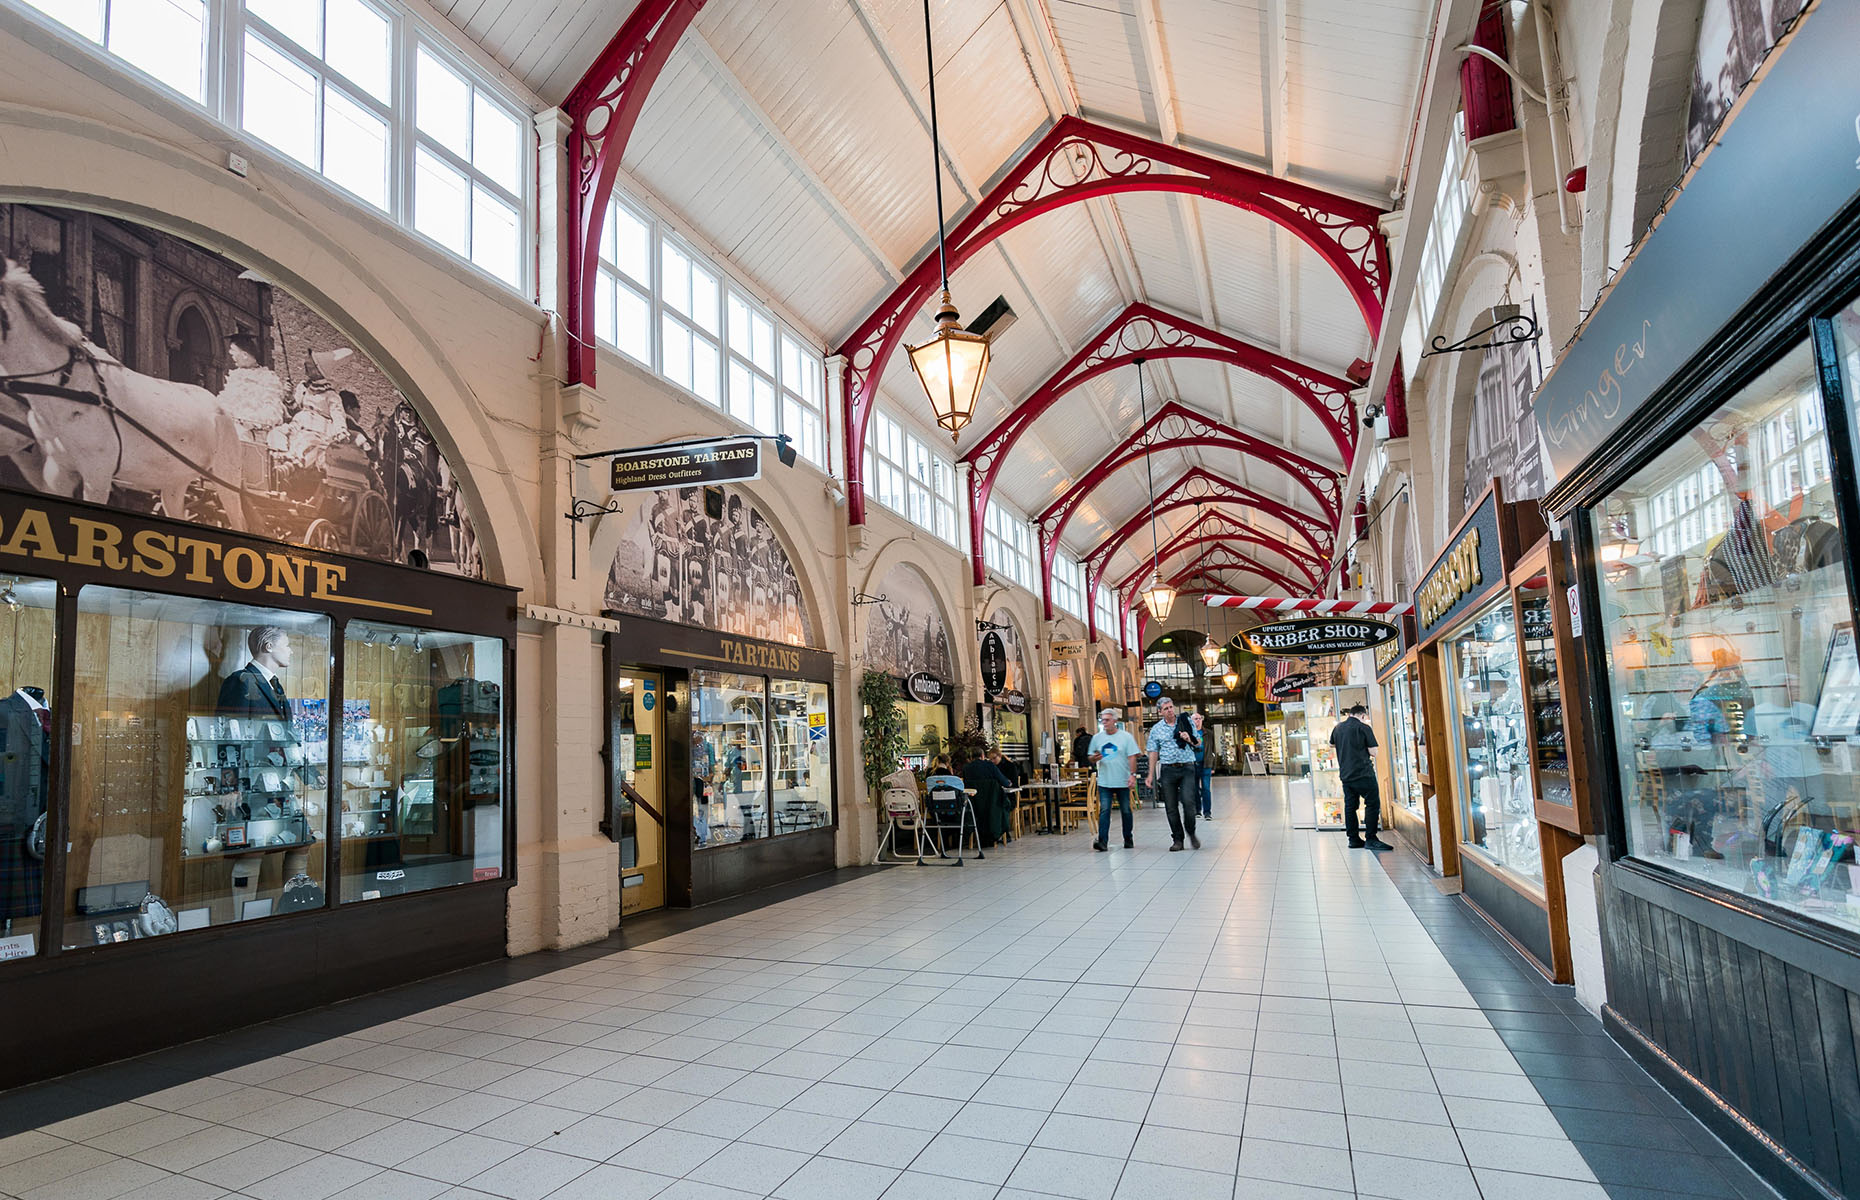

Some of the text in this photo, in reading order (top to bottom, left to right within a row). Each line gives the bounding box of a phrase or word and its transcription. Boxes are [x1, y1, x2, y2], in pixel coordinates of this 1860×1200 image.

[1546, 319, 1652, 450] Ginger
[615, 447, 755, 473] BOARSTONE TARTANS
[615, 468, 702, 486] Highland Dress Outfitters
[0, 507, 347, 600] ARSTONE
[1249, 624, 1370, 648] BARBER SHOP
[1262, 624, 1296, 633] UPPERCUT
[720, 639, 800, 673] TARTANS
[1307, 642, 1337, 650] WALK-INS
[988, 632, 998, 687] Ambiance
[914, 674, 941, 695] Ambiance
[1273, 682, 1291, 694] Arcade
